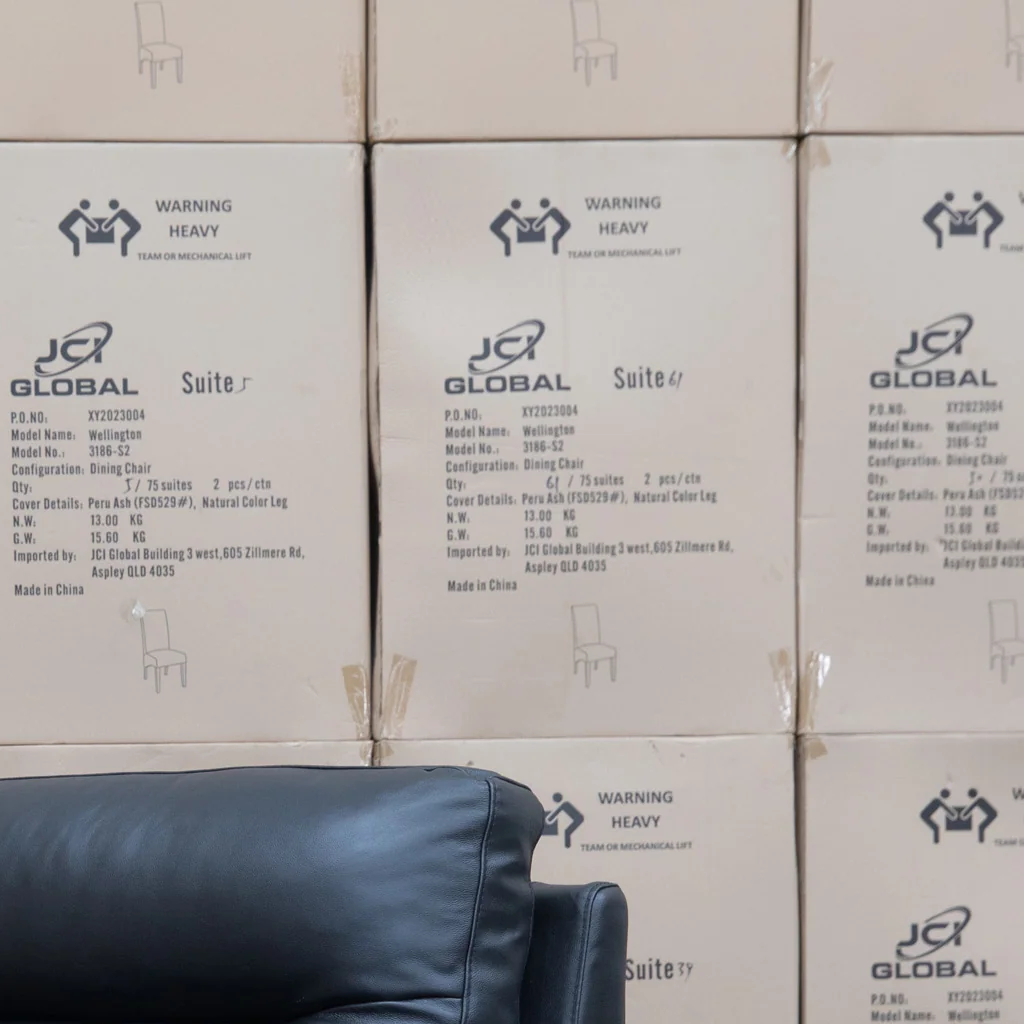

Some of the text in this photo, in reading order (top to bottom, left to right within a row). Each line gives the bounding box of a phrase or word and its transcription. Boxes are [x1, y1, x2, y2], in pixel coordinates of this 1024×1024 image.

[156, 200, 232, 212] WARNING
[585, 196, 661, 210] WARNING
[170, 224, 219, 238] HEAVY
[599, 221, 648, 235] HEAVY
[164, 252, 176, 260] OR
[178, 252, 232, 260] MECHANICAL
[236, 252, 251, 260] LIFT
[594, 250, 606, 258] OR
[608, 249, 662, 257] MECHANICAL
[665, 248, 680, 256] LIFT
[182, 371, 233, 394] Suite
[444, 374, 572, 395] GLOBAL
[614, 366, 664, 390] Suite
[870, 369, 997, 389] GLOBAL
[10, 378, 139, 397] GLOBAL
[522, 404, 578, 418] XY2023004
[523, 424, 574, 438] Wellington
[12, 446, 41, 458] Model
[89, 444, 130, 457] 3186-S2
[90, 462, 122, 476] Dining
[125, 462, 151, 474] Chair
[92, 565, 174, 580] Aspley QLD 4035
[598, 791, 673, 804] WARNING
[612, 816, 660, 828] HEAVY
[607, 843, 618, 851] OR
[620, 842, 675, 850] MECHANICAL
[626, 958, 674, 980] Suite
[871, 960, 997, 980] GLOBAL
